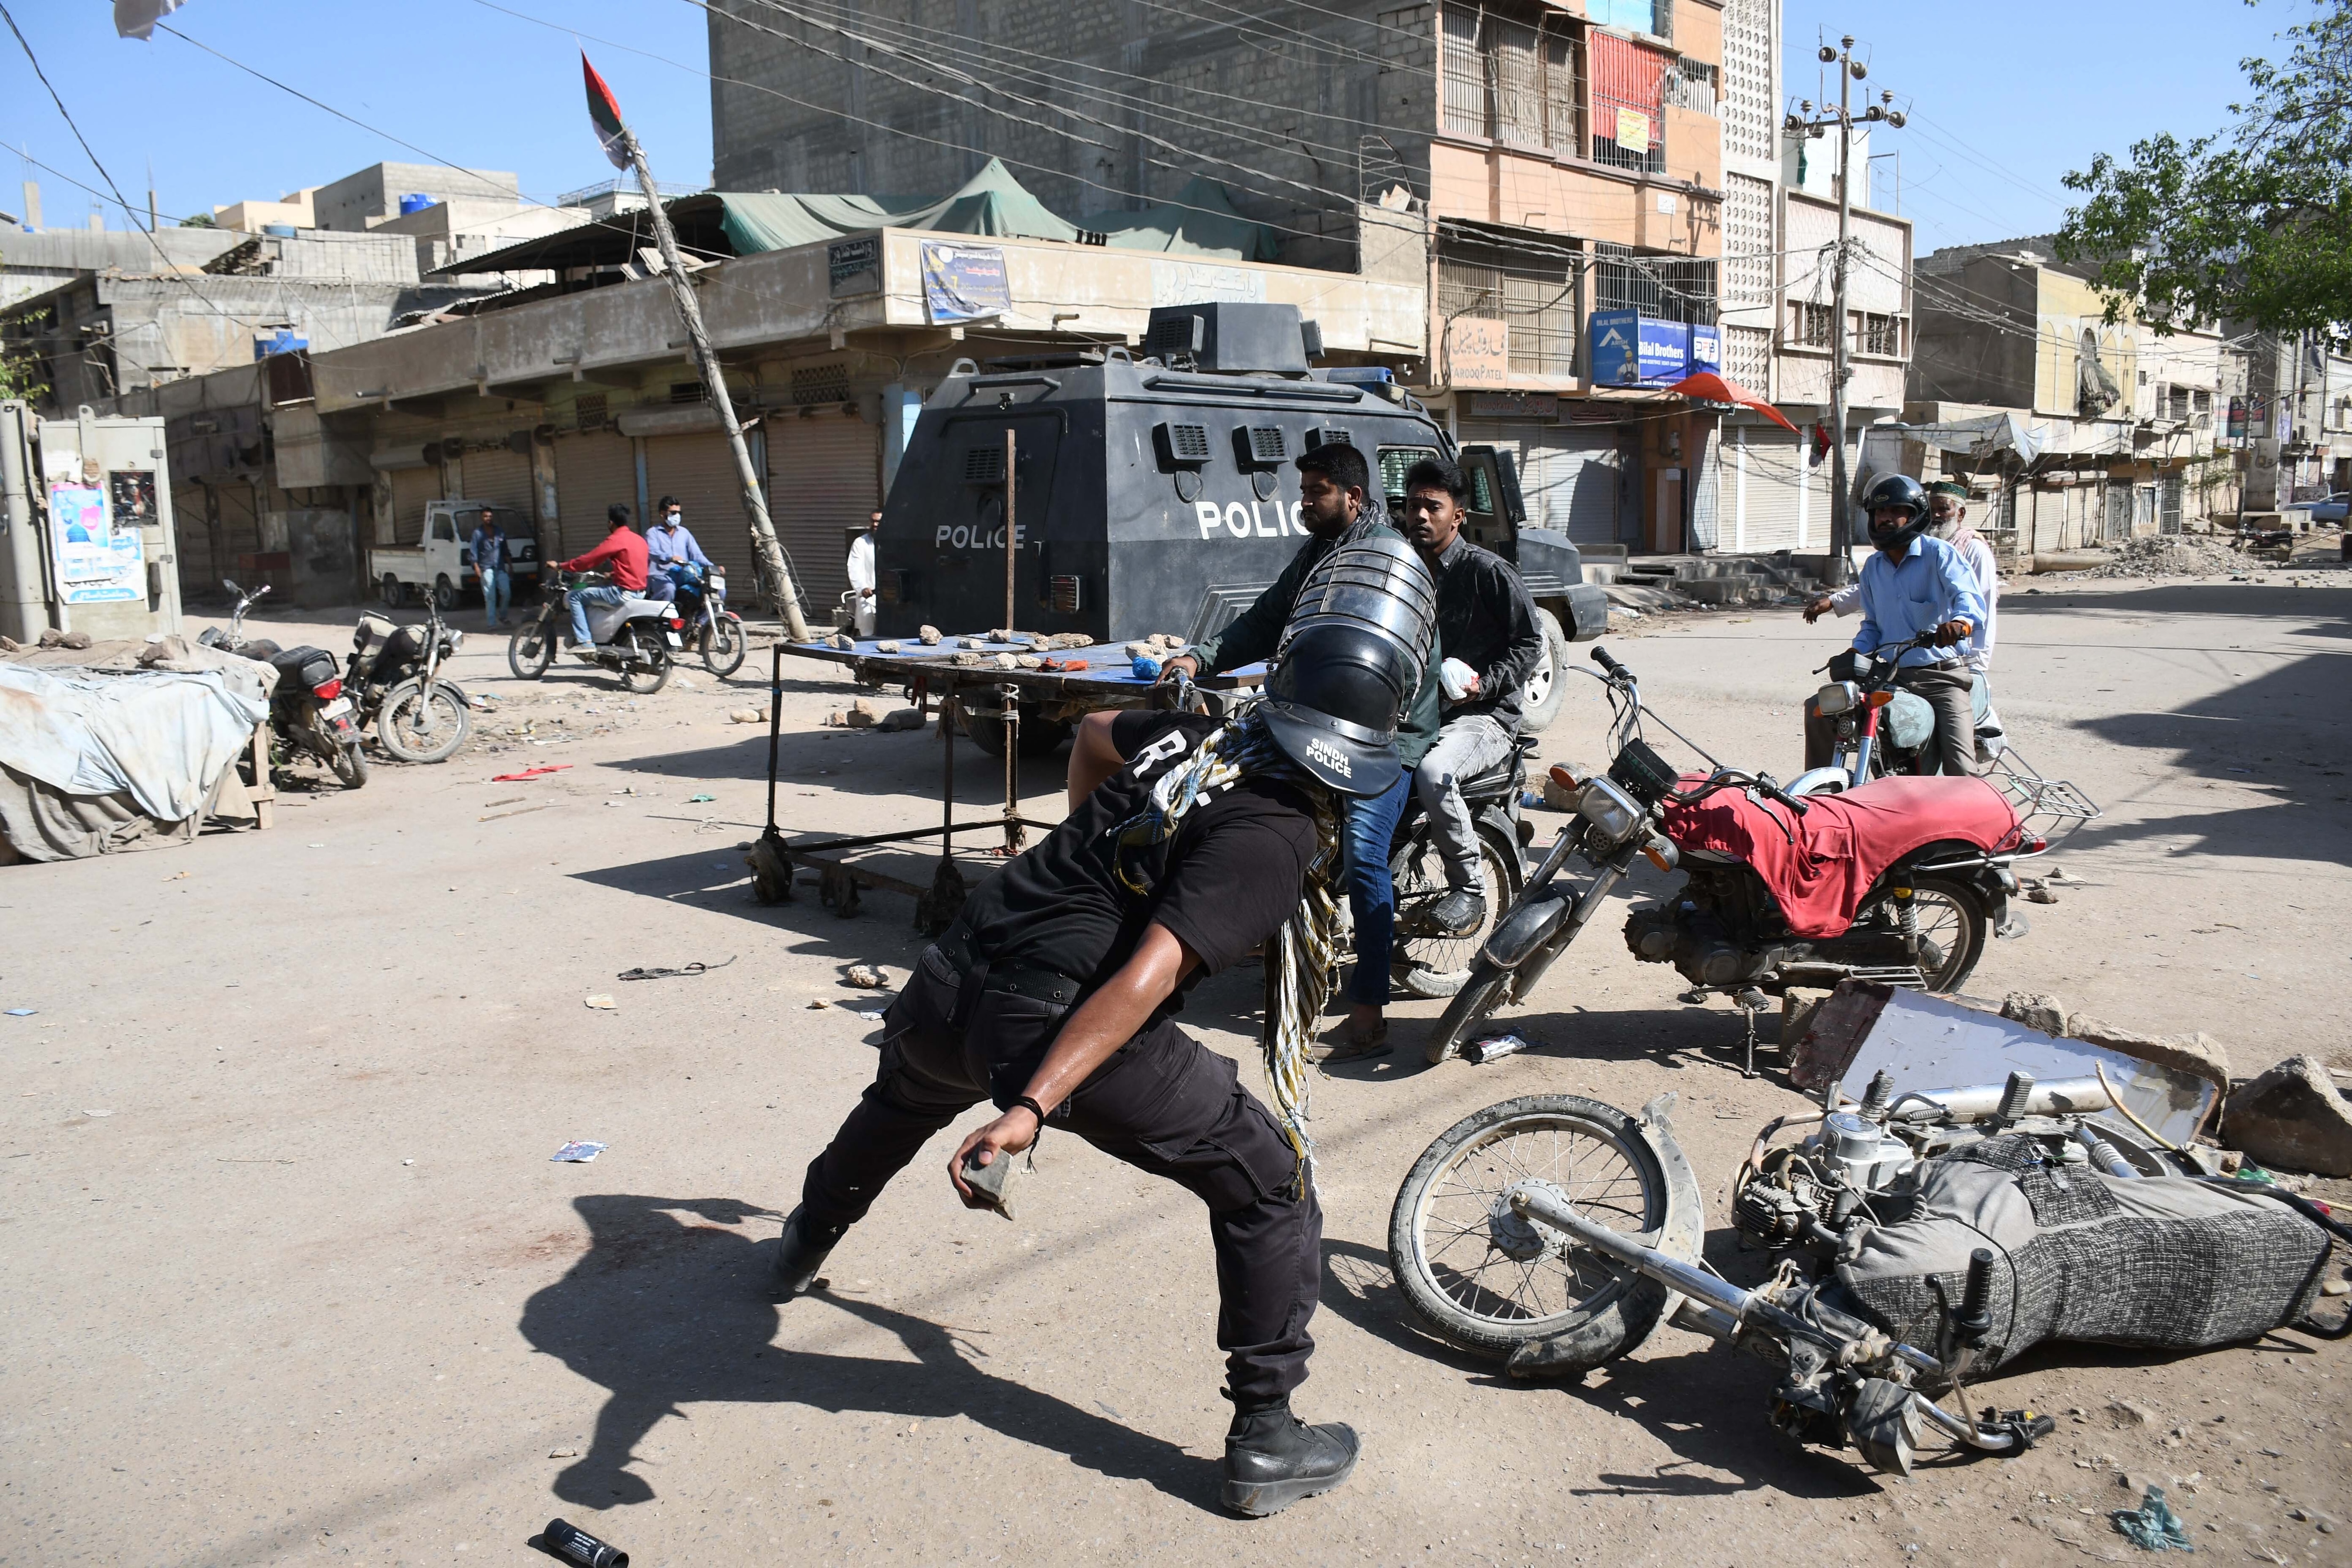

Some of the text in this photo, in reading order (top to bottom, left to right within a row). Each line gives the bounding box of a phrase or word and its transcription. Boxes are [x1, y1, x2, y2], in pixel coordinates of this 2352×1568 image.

[1639, 341, 1684, 359] Bilal Brothers
[1195, 501, 1311, 540] POLIC
[936, 525, 1026, 549] POLICE
[1306, 745, 1352, 779] POLICE
[1311, 738, 1349, 765] SINDH
